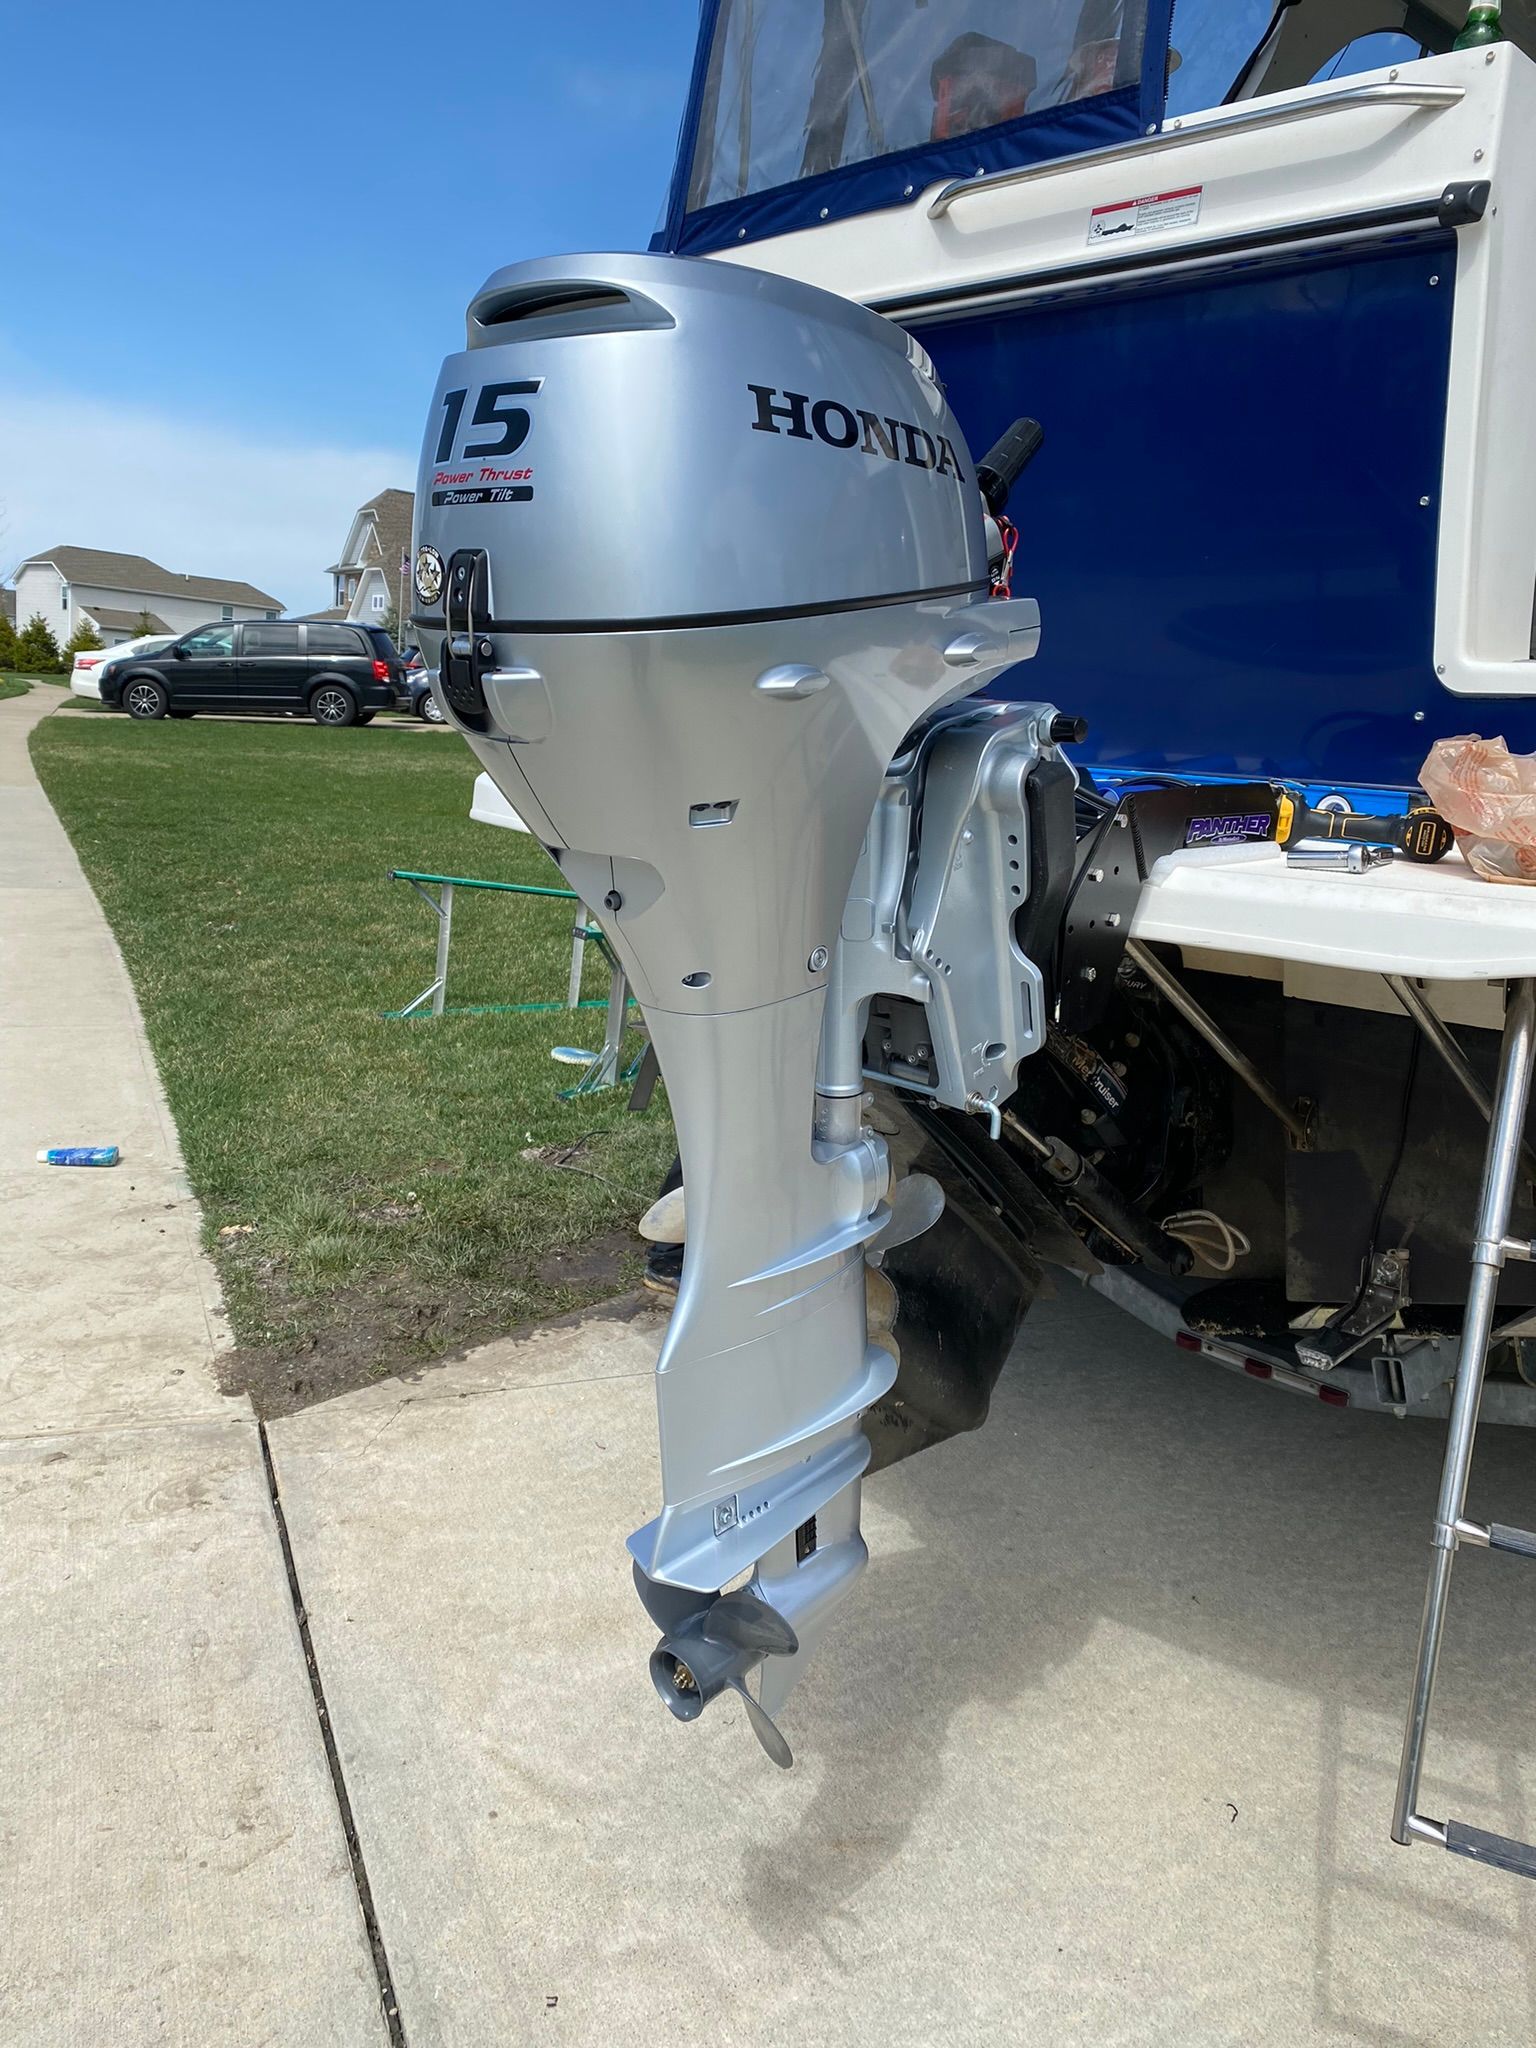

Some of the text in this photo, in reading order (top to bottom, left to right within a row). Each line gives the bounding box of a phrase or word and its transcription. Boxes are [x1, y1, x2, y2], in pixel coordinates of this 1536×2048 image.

[433, 378, 544, 466] 15
[747, 384, 966, 483] HONDA
[433, 467, 534, 486] Power Thrust
[443, 487, 514, 504] Power Tilt
[1186, 814, 1271, 844] PANTHER
